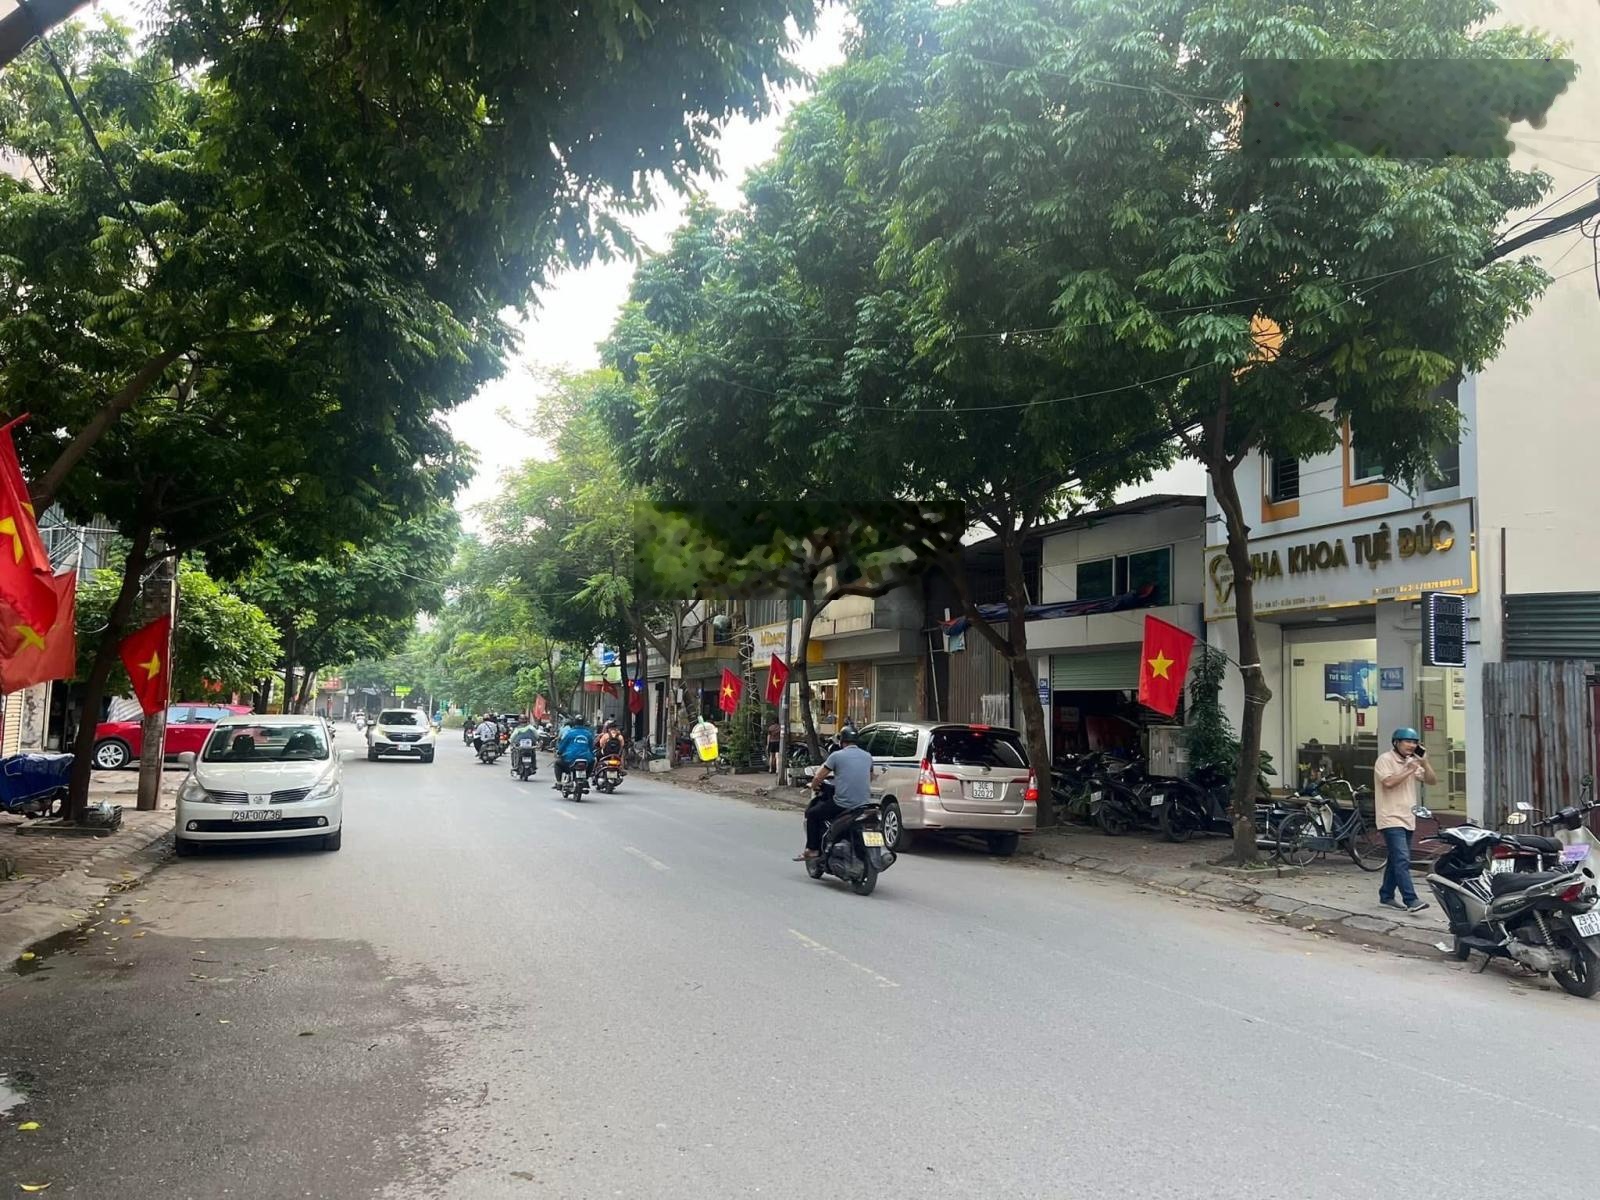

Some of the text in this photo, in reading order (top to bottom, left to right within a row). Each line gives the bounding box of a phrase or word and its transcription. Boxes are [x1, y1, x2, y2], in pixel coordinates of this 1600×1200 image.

[1288, 538, 1348, 575] KHOA
[1351, 522, 1392, 569] TUỆ
[1398, 511, 1455, 559] ĐỨC
